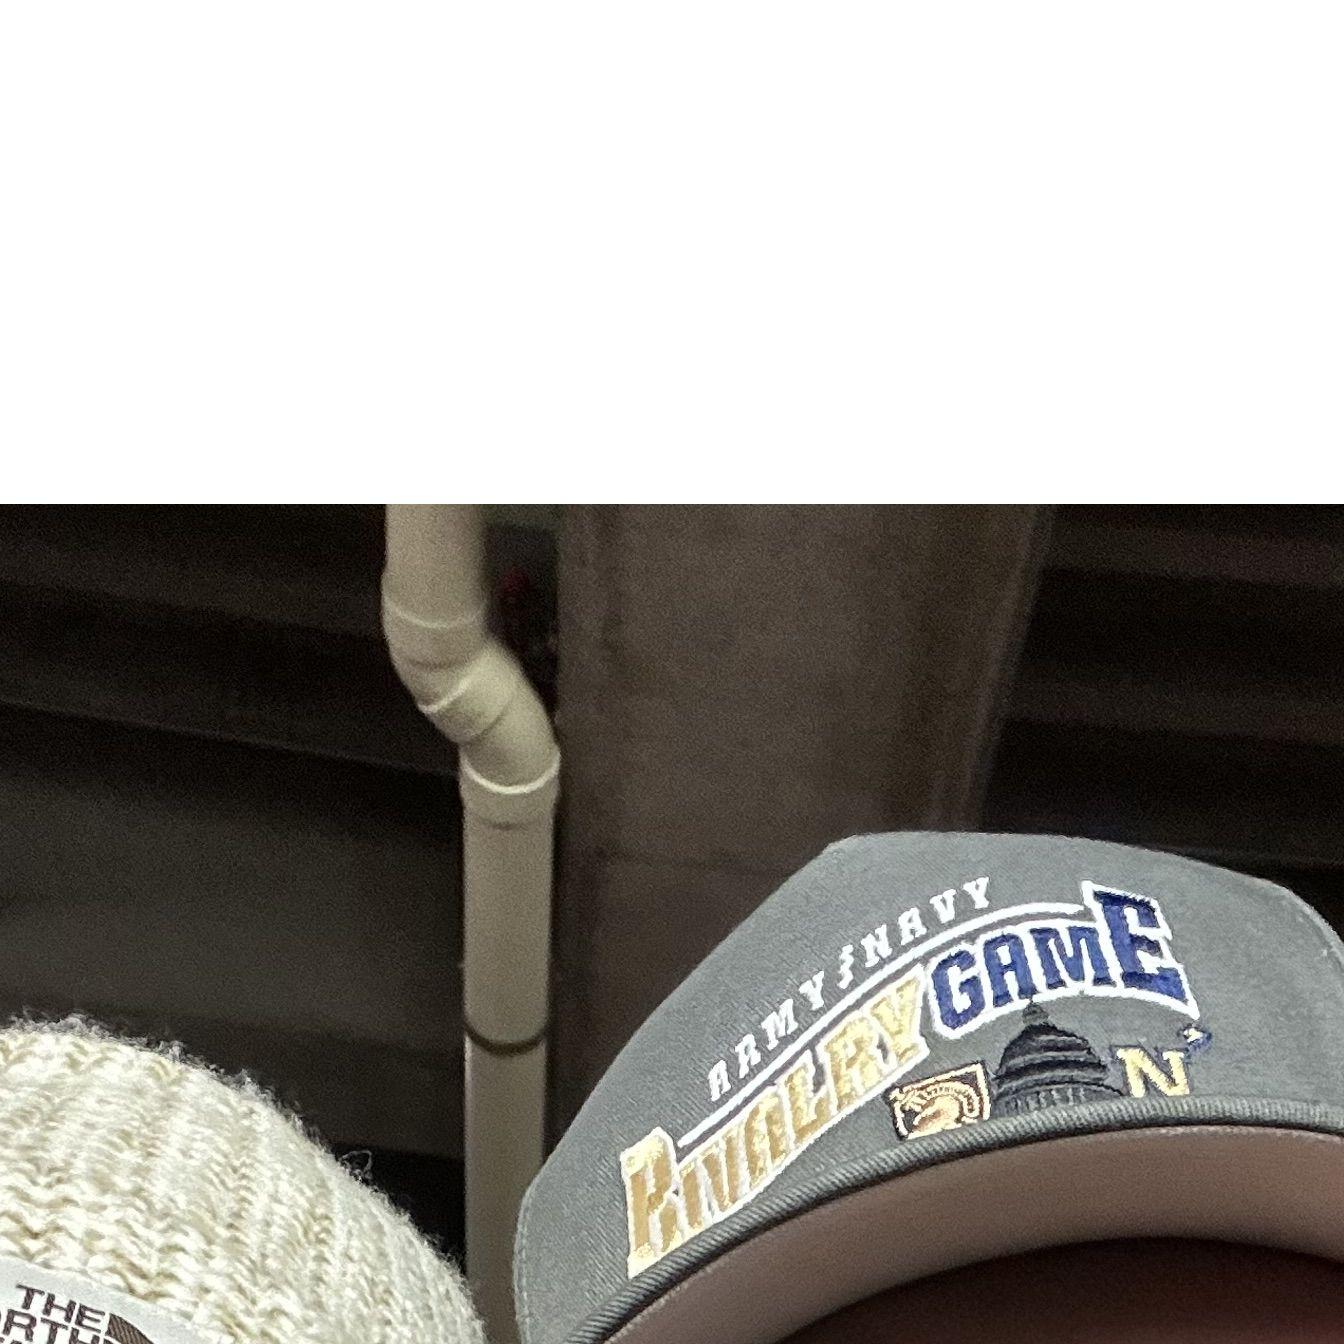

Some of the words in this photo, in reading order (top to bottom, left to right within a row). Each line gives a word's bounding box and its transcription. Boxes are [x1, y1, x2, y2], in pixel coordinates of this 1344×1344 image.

[707, 970, 825, 1101] ARMY
[860, 876, 990, 968] NAVY
[620, 963, 930, 1279] RIVALRY
[924, 881, 1199, 1039] GAME
[1116, 1047, 1190, 1098] N
[16, 1284, 105, 1334] THE
